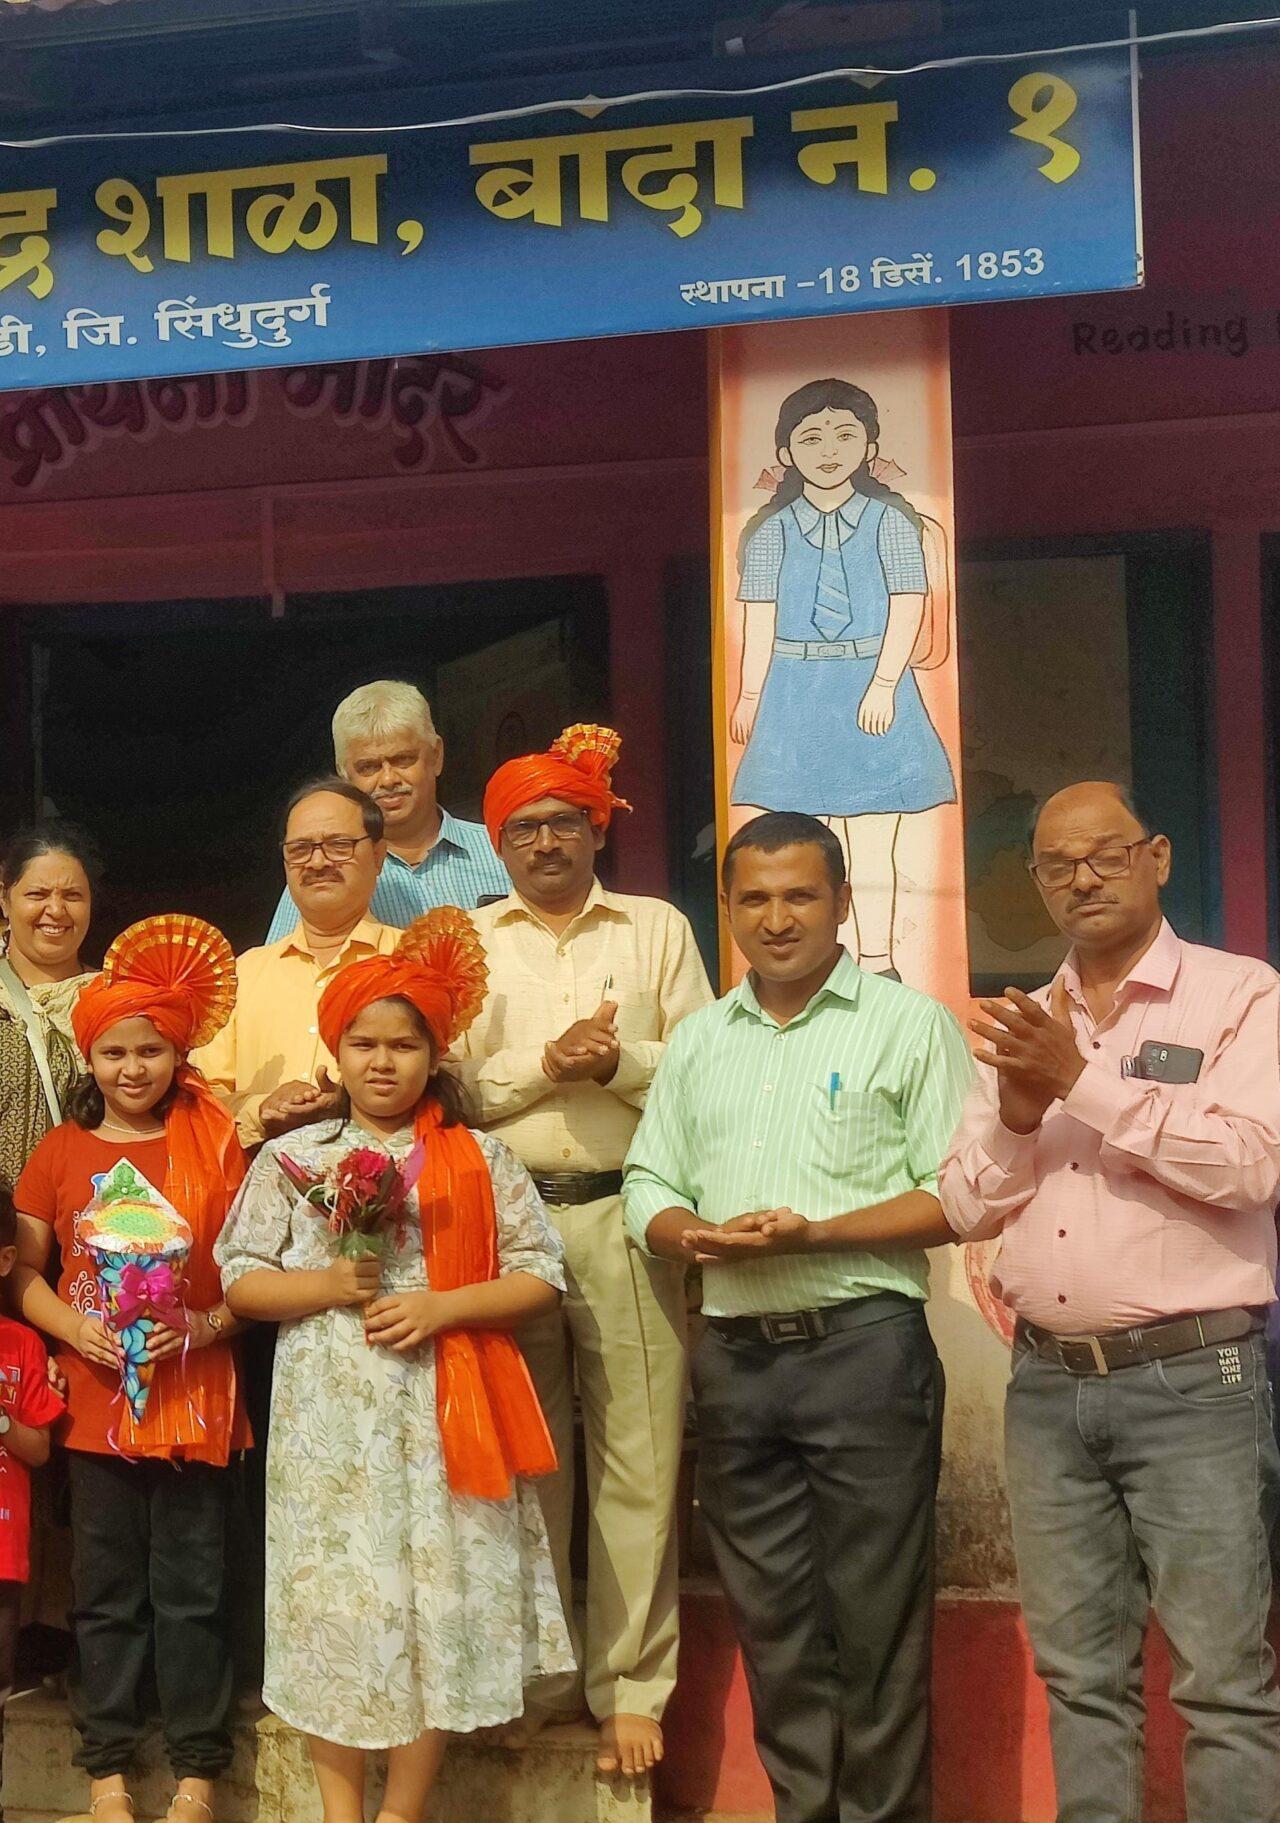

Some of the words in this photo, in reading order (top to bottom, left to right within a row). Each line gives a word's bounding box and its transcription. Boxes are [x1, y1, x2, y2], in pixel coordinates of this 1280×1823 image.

[95, 154, 423, 273] शाळा,
[1007, 72, 1080, 183] १
[680, 275, 786, 306] स्थापना
[955, 248, 1044, 280] 1853
[62, 307, 136, 350] जि.
[154, 284, 330, 349] सिंधुदुर्ग
[1071, 310, 1249, 357] Reading
[1217, 1346, 1239, 1357] YOU
[1219, 1357, 1240, 1366] HAVE
[1221, 1365, 1241, 1374] ONE
